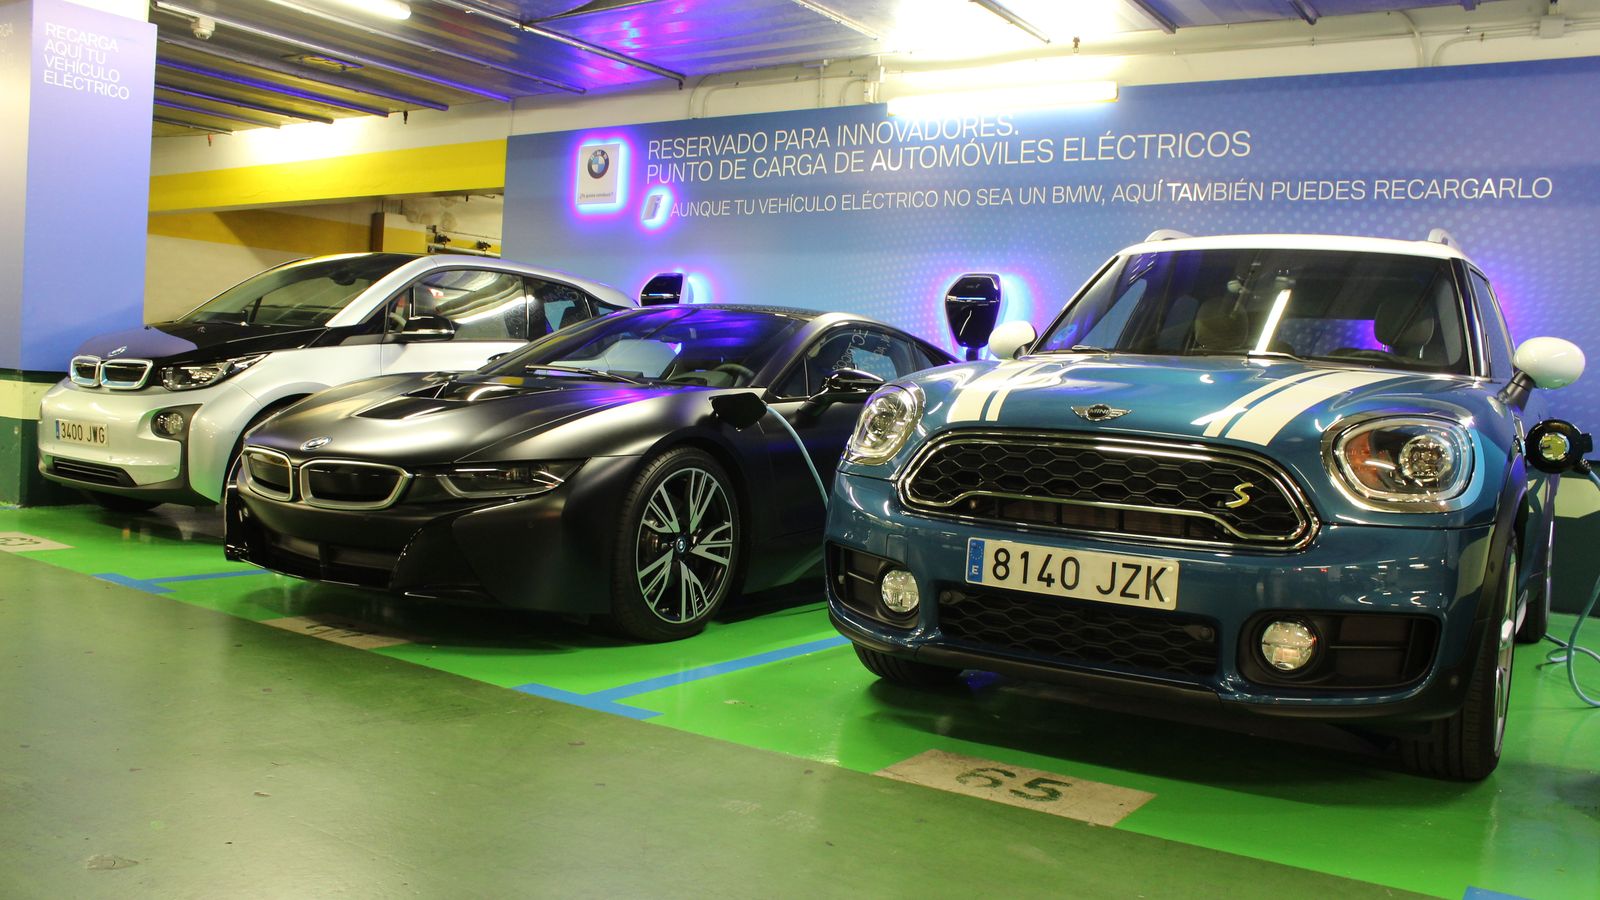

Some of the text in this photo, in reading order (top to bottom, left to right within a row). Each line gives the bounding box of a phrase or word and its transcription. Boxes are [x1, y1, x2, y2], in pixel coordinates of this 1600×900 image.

[44, 38, 106, 65] AQUÍ TU
[45, 22, 119, 53] RECARGA
[44, 54, 120, 83] VEHÍCULO
[44, 69, 130, 100] ELÉCTRICO
[648, 114, 1019, 160] RESERVADO PARA INNOVADORES.
[647, 130, 1252, 184] PUNTO DE CARGA DE AUTOMÓVILES ELÉCTRICOS
[670, 177, 1553, 217] AUNQUE TU VEHÍCULO ELÉCTRICO NO SEA UN BMW, AQUÍ TAMBIÉN PUEDES RECARGARLO
[61, 422, 105, 443] 3400 JWG
[972, 548, 1167, 603] E 8140 JZK
[955, 767, 1073, 801] 65
